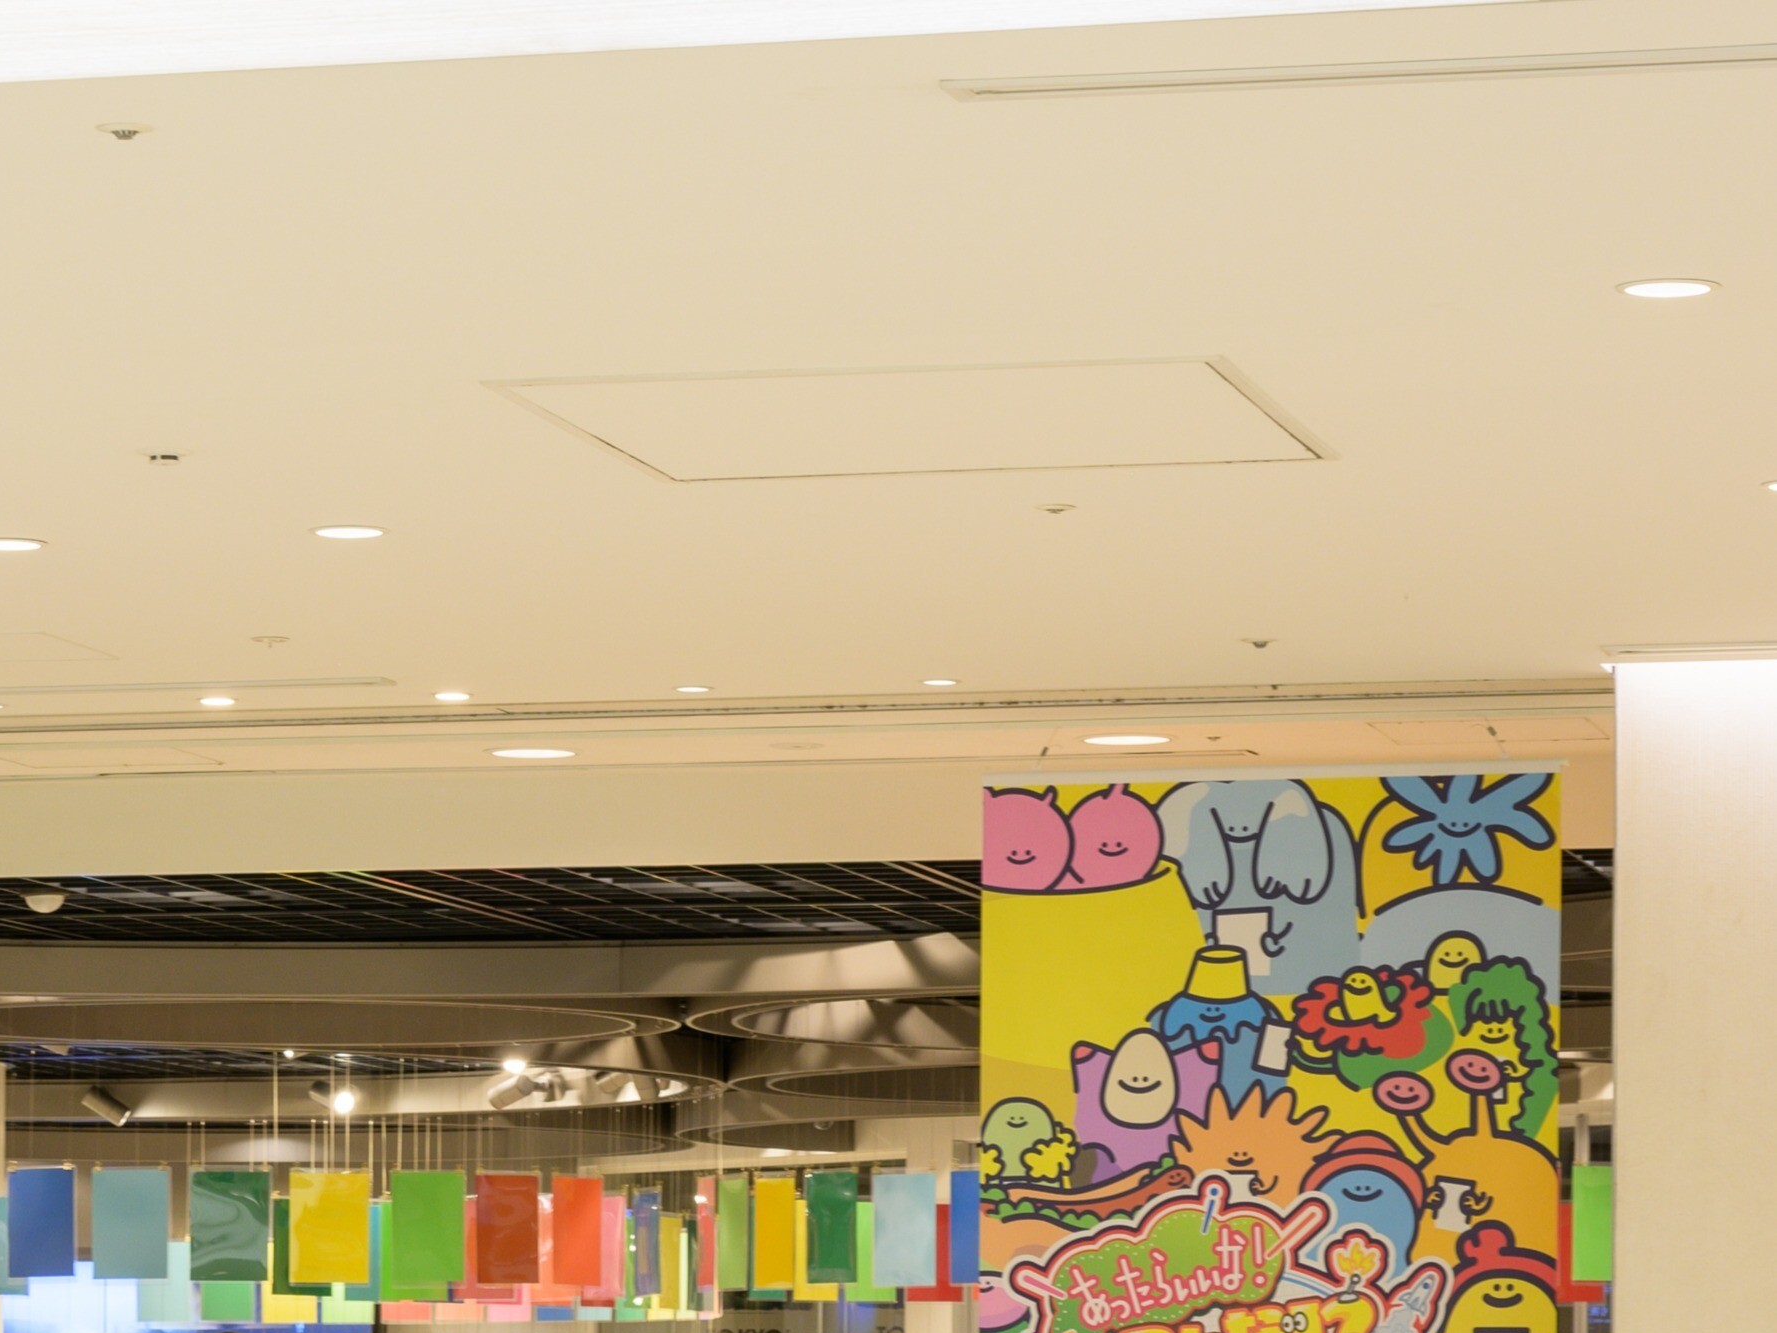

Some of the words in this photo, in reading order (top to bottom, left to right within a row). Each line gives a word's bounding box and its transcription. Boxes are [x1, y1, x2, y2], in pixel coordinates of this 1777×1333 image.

[1070, 1225, 1267, 1325] あったらいいな!
